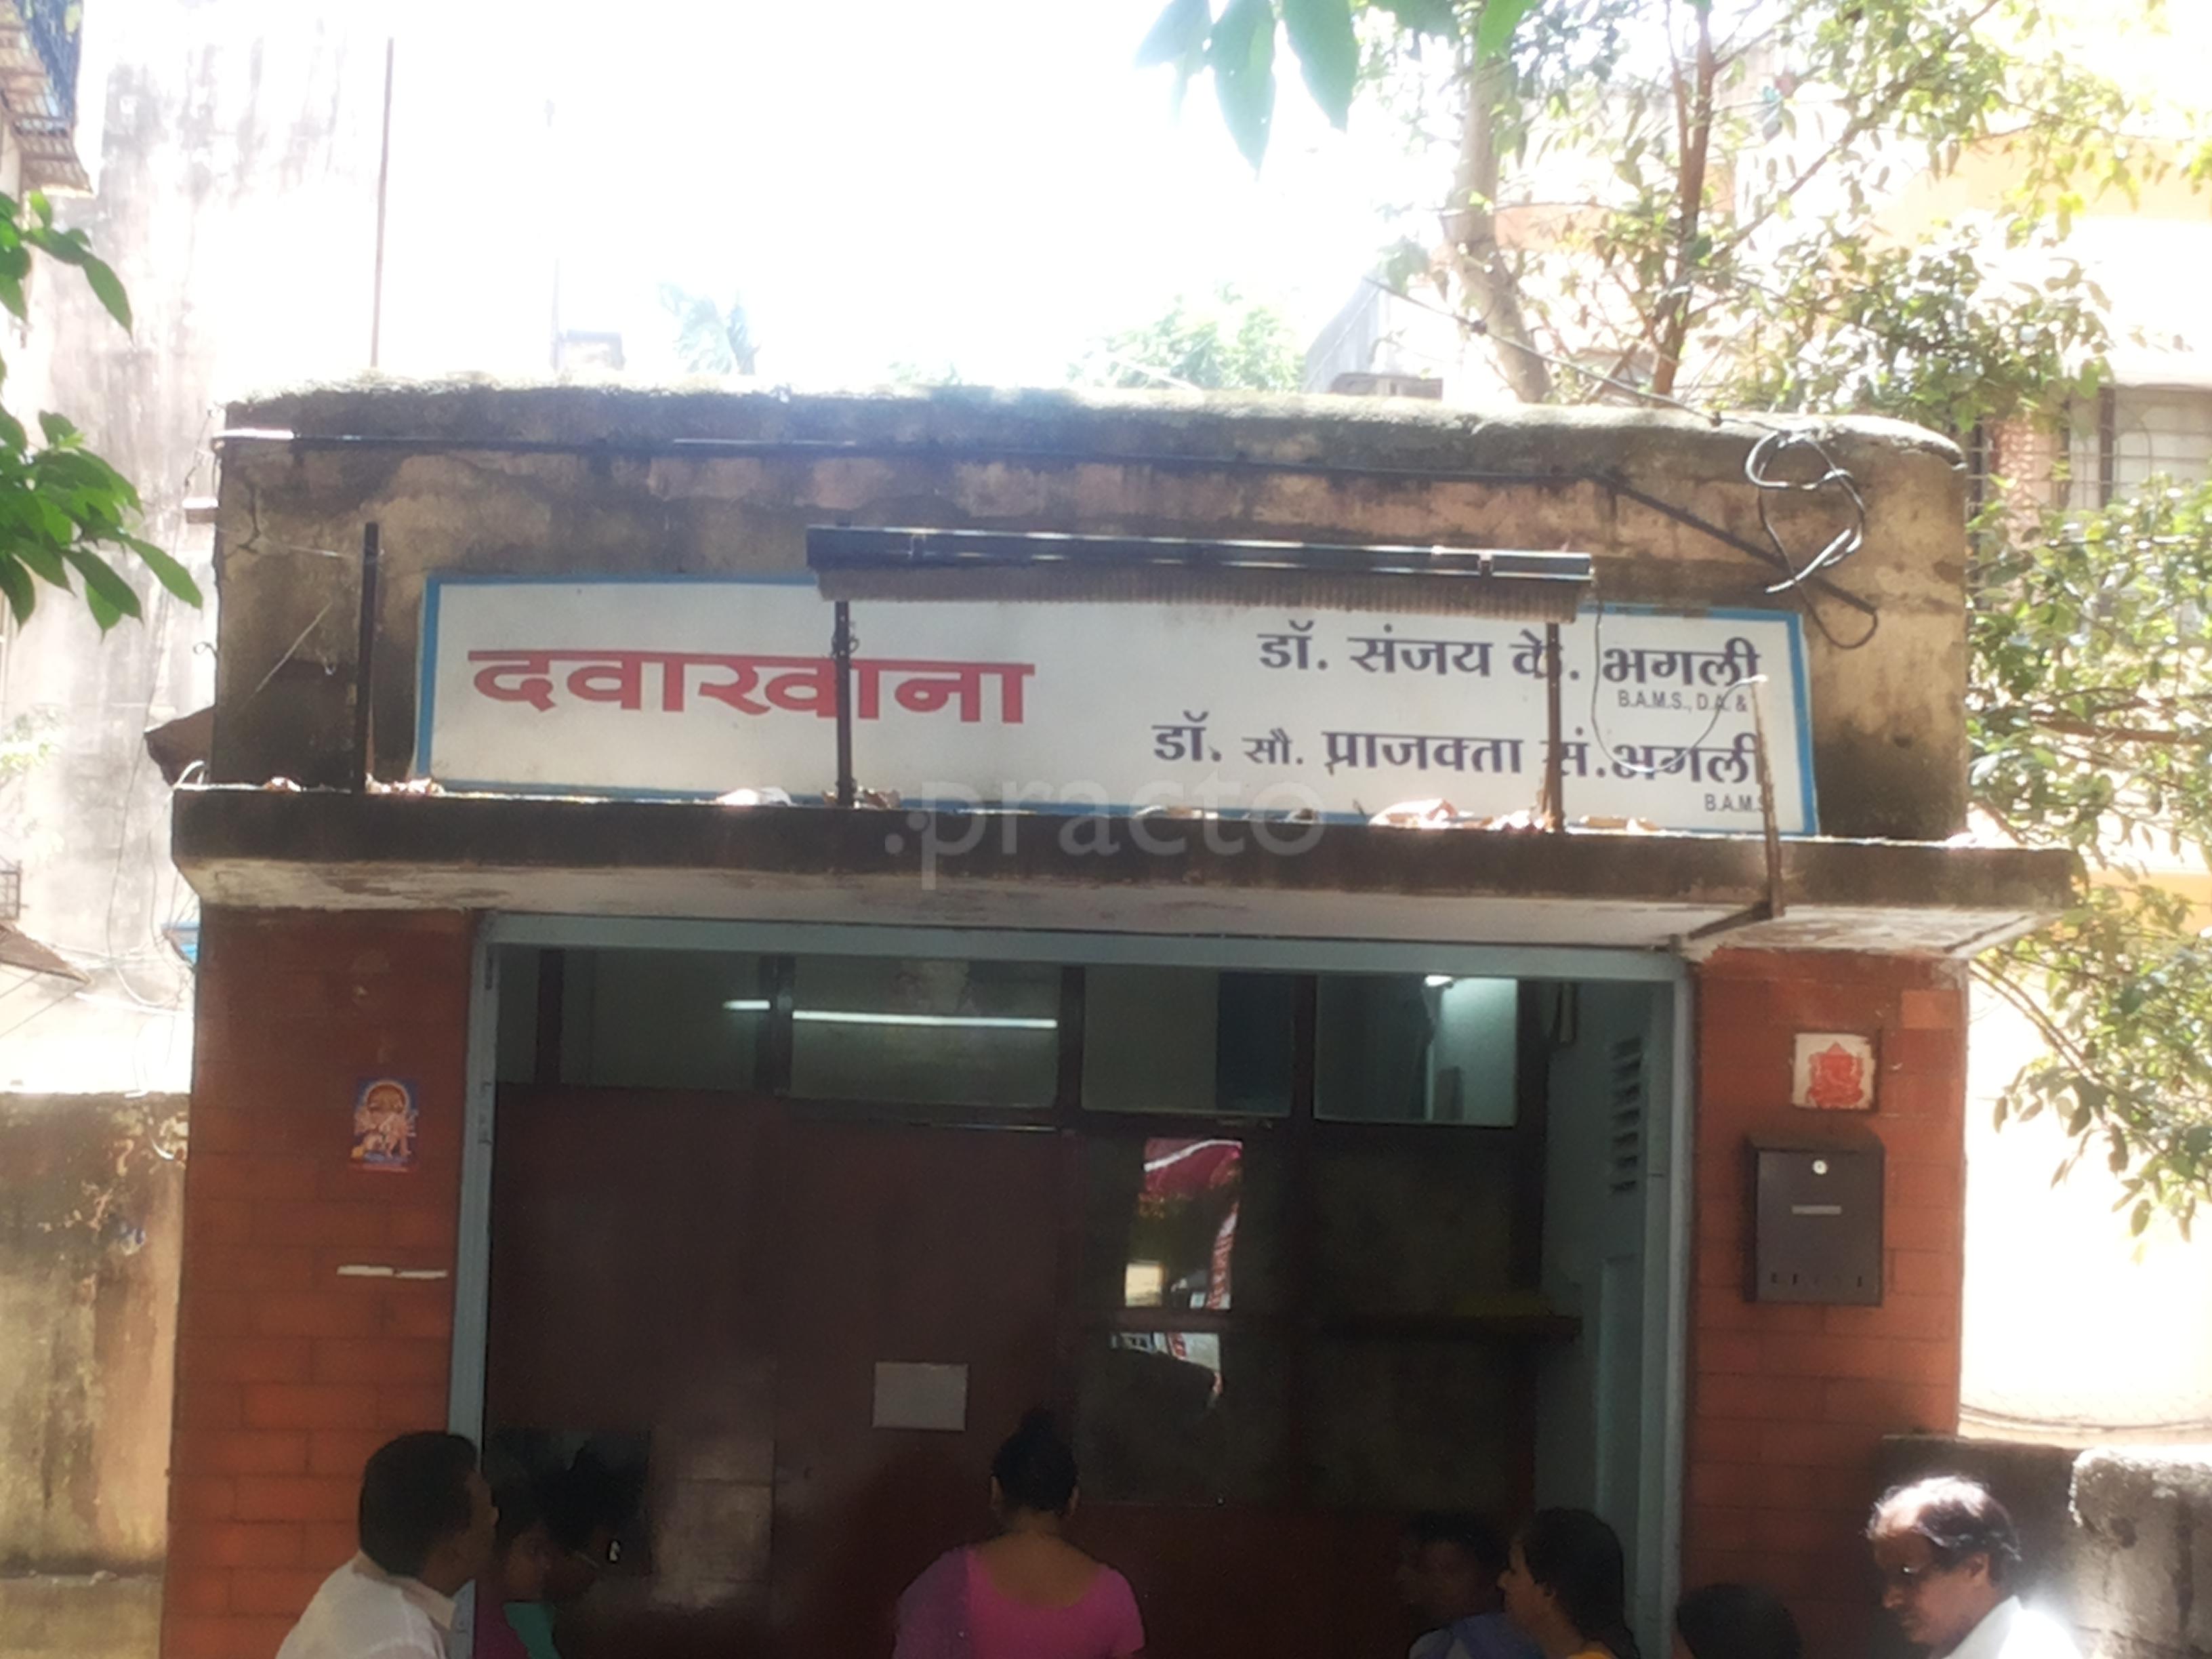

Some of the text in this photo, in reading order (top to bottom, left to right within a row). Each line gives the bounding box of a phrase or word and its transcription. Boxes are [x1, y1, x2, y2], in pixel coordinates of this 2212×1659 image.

[468, 649, 1036, 724] दवाखाना
[1256, 619, 1328, 671] डॉ.
[1347, 623, 1494, 678] संजय
[1602, 636, 1761, 687] भगली
[1151, 710, 1222, 762] डॉ.
[1241, 727, 1304, 766] सौ.
[1321, 731, 1524, 776] प्राजक्ता
